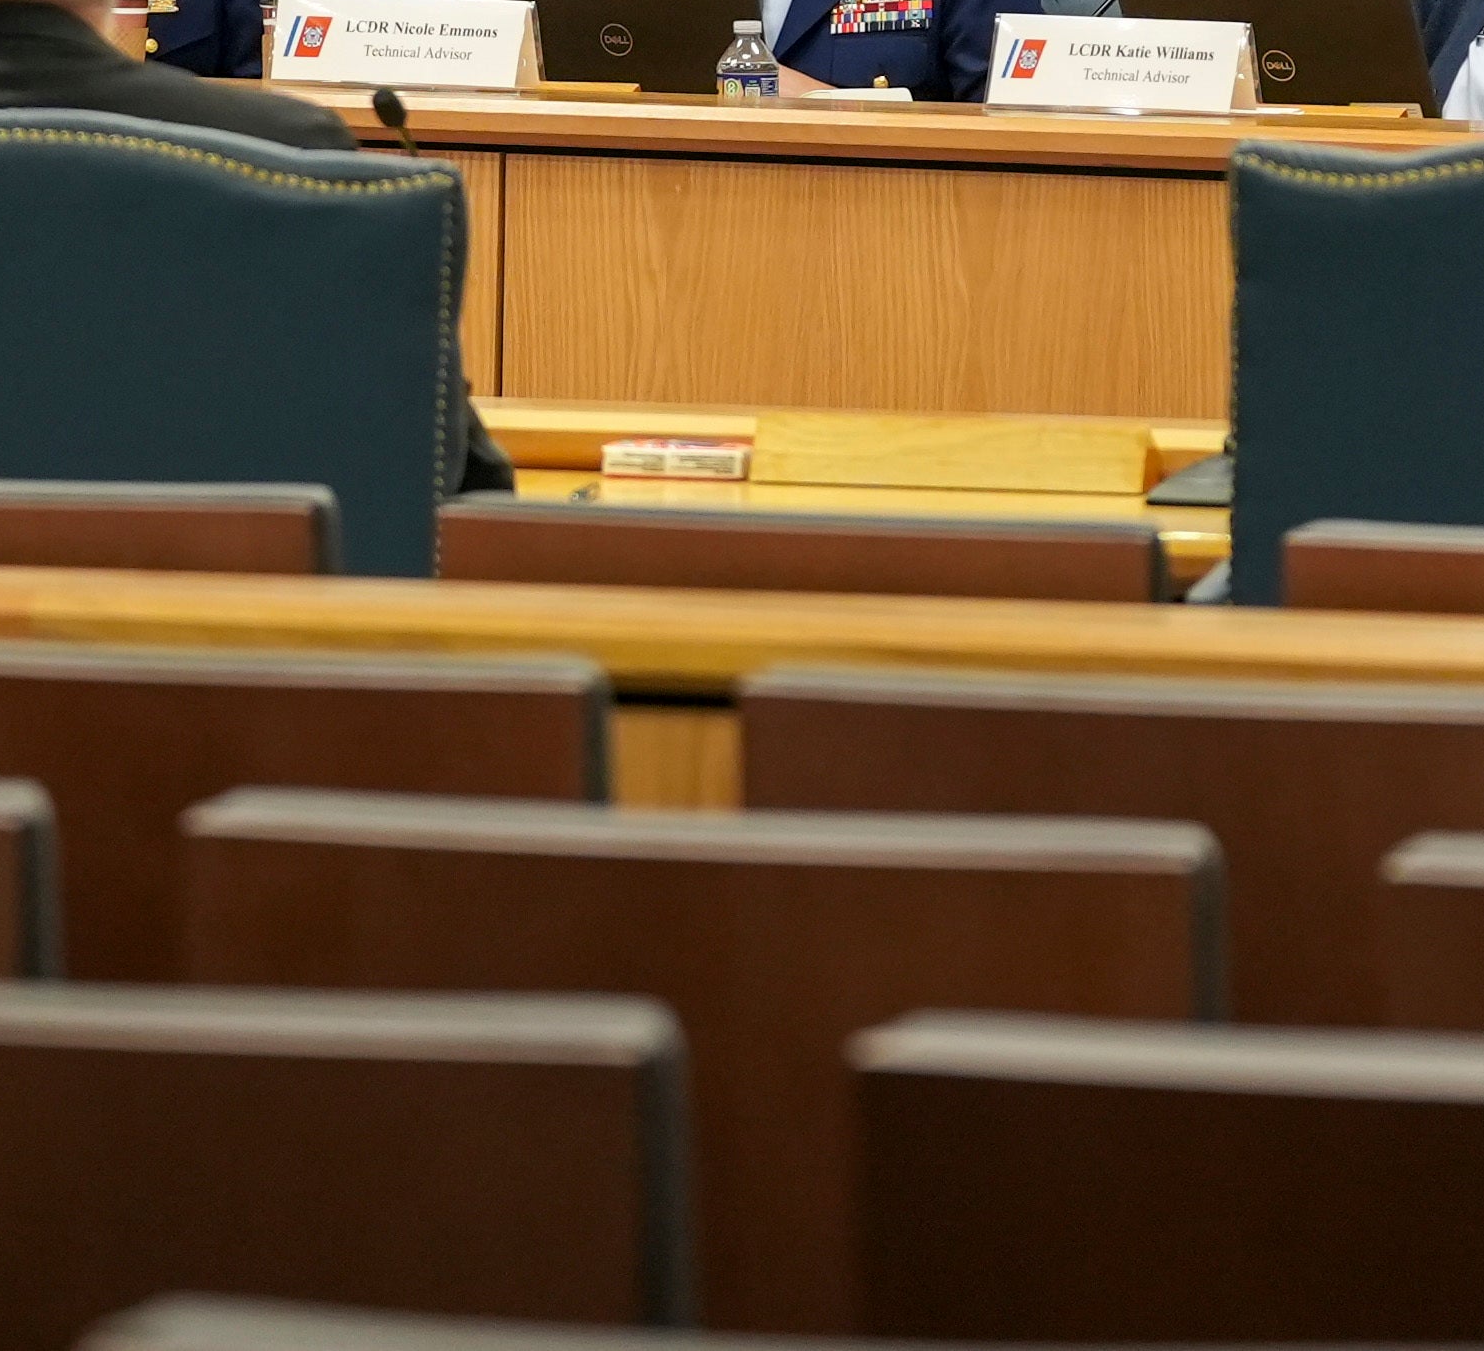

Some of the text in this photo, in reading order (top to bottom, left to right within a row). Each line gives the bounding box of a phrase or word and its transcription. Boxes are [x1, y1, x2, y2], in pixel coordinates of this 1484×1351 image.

[346, 20, 498, 39] LCDR Nicole Emmons
[364, 44, 473, 61] Technical Advisor
[1068, 42, 1214, 61] LCDR Katie Williams
[1083, 68, 1190, 84] Technical Advisor
